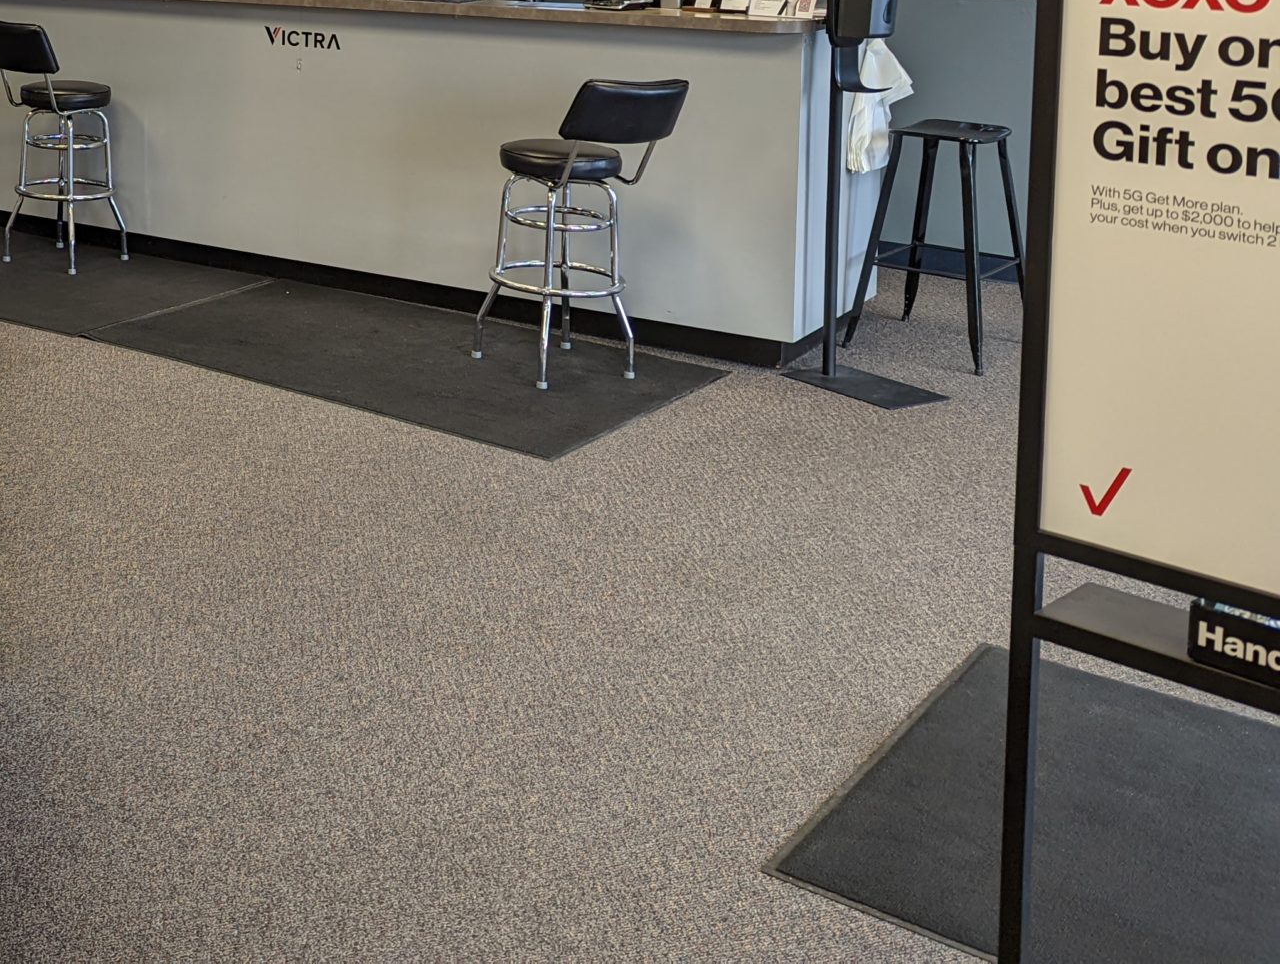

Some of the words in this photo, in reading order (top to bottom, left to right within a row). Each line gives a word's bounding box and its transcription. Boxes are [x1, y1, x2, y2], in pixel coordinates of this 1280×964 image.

[264, 26, 340, 50] VICTRA
[1098, 16, 1208, 71] Buy
[1095, 68, 1218, 119] best
[1228, 79, 1280, 123] 5
[1092, 120, 1195, 170] Gift
[1207, 143, 1280, 179] on
[1090, 197, 1120, 214] Plus,
[1122, 204, 1144, 216] get
[1146, 208, 1164, 218] up
[1166, 208, 1179, 220] to
[1237, 218, 1251, 230] to
[1091, 184, 1120, 199] With
[1122, 188, 1143, 202] 5G
[1145, 192, 1169, 206] Get
[1172, 195, 1208, 211] More
[1211, 201, 1244, 216] plan.
[1090, 212, 1118, 225] your
[1120, 217, 1149, 229] cost
[1152, 220, 1188, 235] when
[1190, 226, 1216, 238] you
[1218, 231, 1264, 246] switch
[1266, 234, 1277, 248] 2
